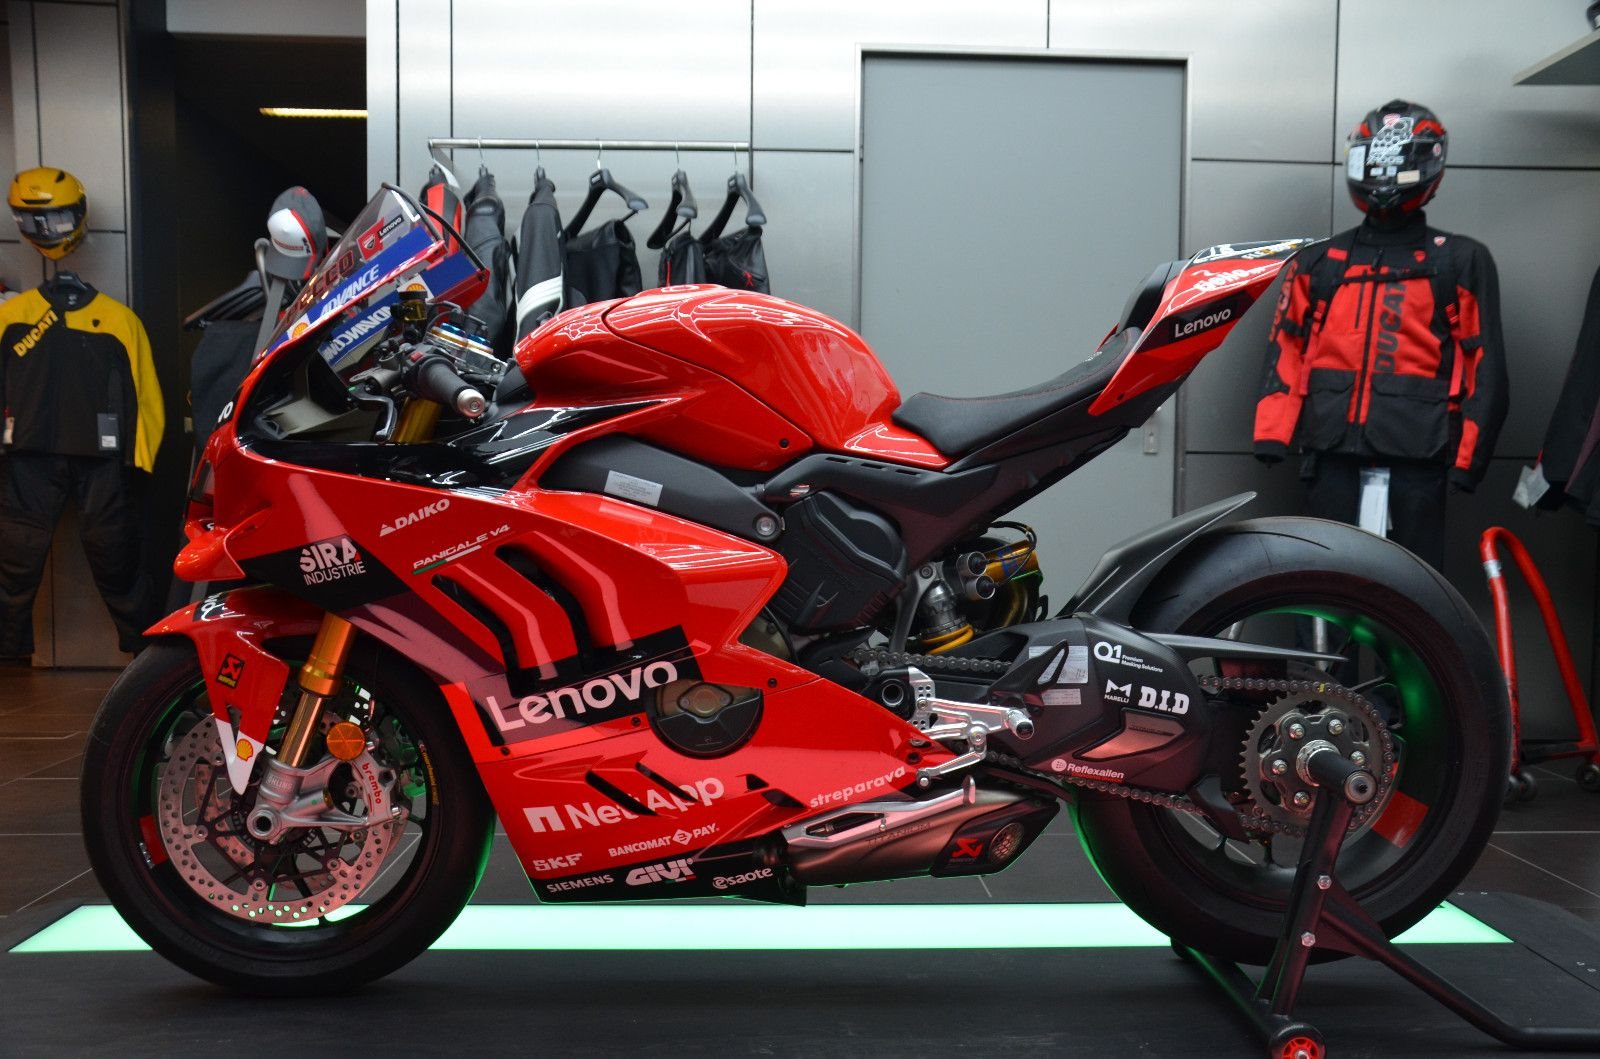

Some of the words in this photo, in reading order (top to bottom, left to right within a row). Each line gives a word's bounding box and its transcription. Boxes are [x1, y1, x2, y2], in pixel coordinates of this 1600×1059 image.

[379, 217, 402, 236] Lenovo
[320, 264, 380, 317] ADVANCE
[13, 310, 59, 357] DUCATI
[1175, 308, 1231, 338] Lenovo
[394, 498, 450, 530] DAIKO
[300, 537, 360, 573] SIRA
[412, 533, 488, 570] PANIGALE
[489, 524, 511, 538] V4
[303, 561, 367, 586] INDUSTRIE
[1093, 641, 1122, 664] Q1
[486, 660, 678, 732] Lenovo
[1104, 694, 1130, 704] MARELLI
[1137, 685, 1190, 715] D.I.D
[362, 762, 382, 805] brembo
[1066, 762, 1124, 779] Reflexallen
[809, 766, 906, 808] streparava
[608, 835, 672, 857] BANCOMAT
[533, 852, 583, 872] SKF
[546, 874, 615, 893] SIEMENS
